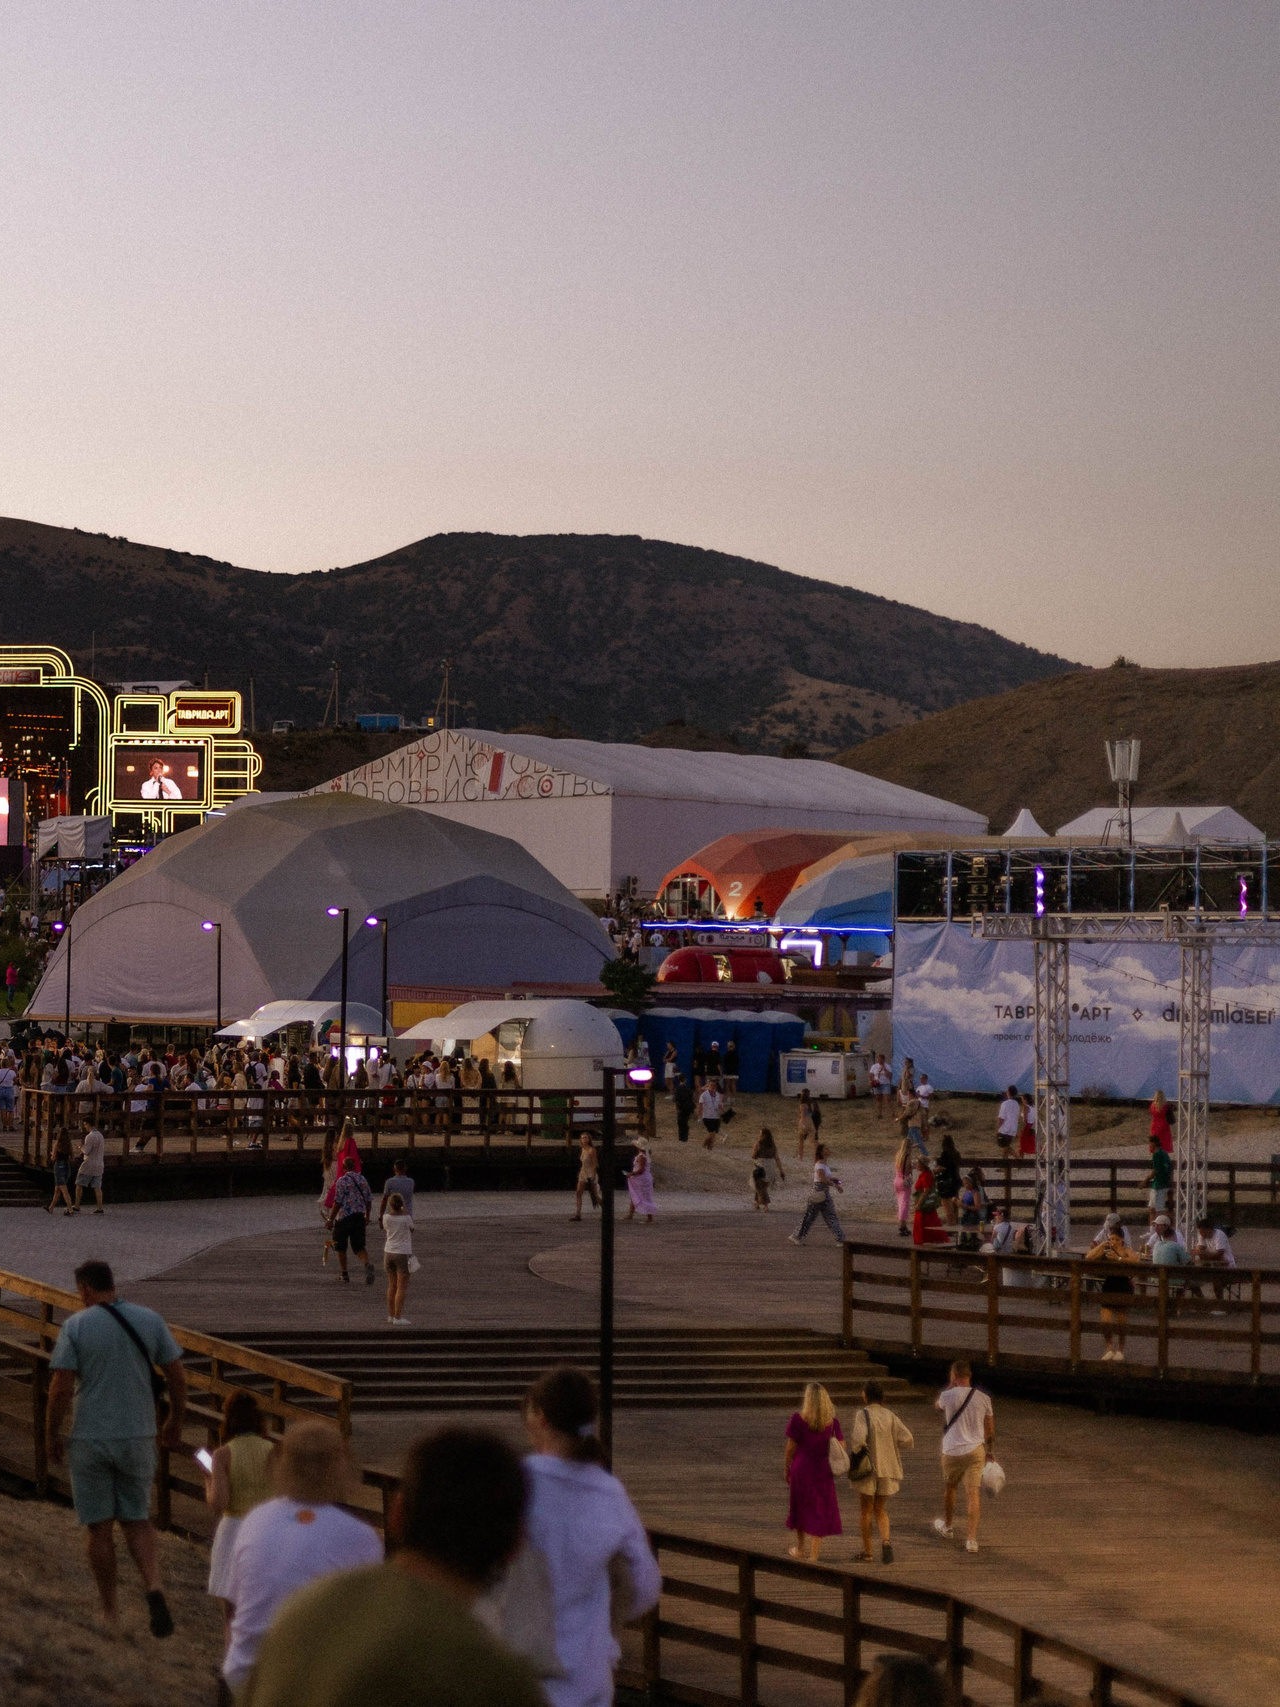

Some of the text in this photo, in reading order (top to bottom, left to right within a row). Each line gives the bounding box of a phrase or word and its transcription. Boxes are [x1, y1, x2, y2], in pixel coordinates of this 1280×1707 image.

[728, 881, 743, 897] 2
[1162, 1001, 1276, 1025] dramlaser
[993, 1033, 1022, 1042] проект
